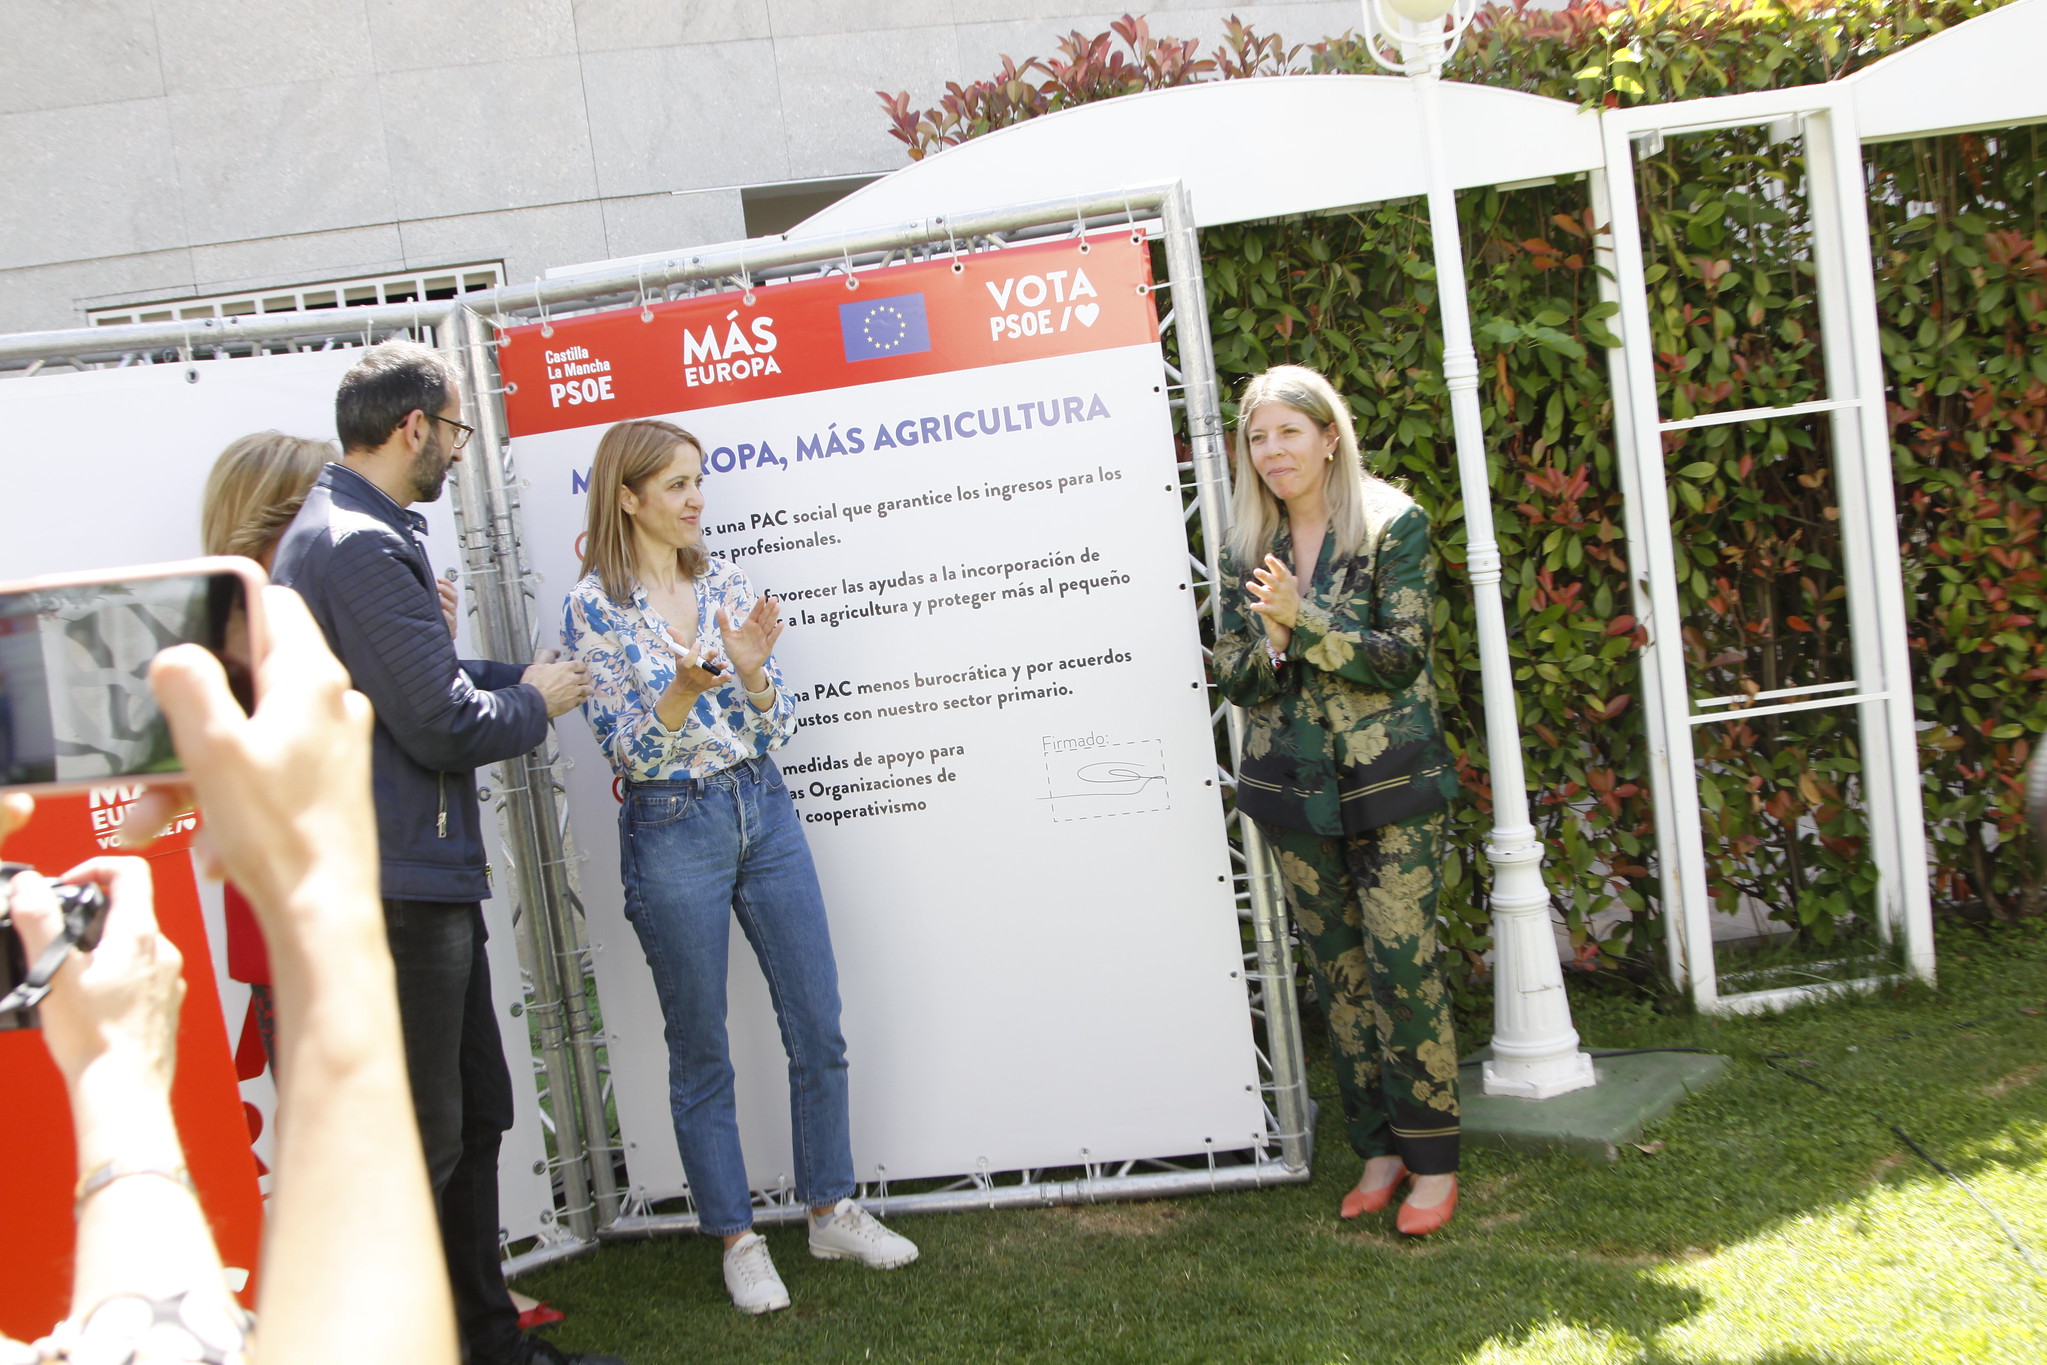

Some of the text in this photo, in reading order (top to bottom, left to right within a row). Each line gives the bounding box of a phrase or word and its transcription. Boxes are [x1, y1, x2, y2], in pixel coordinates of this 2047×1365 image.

[985, 267, 1098, 311] VOTA
[683, 309, 778, 365] MÁS
[990, 309, 1054, 342] PSOE
[545, 345, 589, 364] Castilla
[547, 358, 611, 380] La Mancha
[684, 355, 782, 387] EUROPA
[549, 375, 615, 408] PSOE
[797, 422, 865, 461] MÁS
[873, 392, 1112, 451] AGRICULTURA
[716, 521, 746, 535] una
[750, 510, 789, 530] PAC
[792, 502, 838, 524] social
[842, 503, 872, 523] que
[877, 490, 953, 518] garantice
[956, 485, 980, 501] los
[984, 482, 1053, 501] ingresos
[1057, 472, 1094, 493] para
[1098, 466, 1122, 482] los
[731, 531, 842, 564] profesionales.
[841, 579, 864, 594] las
[868, 570, 925, 596] ayudas
[929, 573, 938, 583] a
[941, 565, 957, 581] la
[961, 551, 1075, 579] incorporación
[1080, 547, 1100, 562] de
[789, 569, 1131, 628] a la agricultura y proteger más al pequeño
[814, 681, 852, 700] PAC
[857, 679, 910, 695] menos
[914, 664, 1007, 688] burocrática
[1012, 665, 1021, 682] y
[1026, 661, 1054, 680] por
[1059, 648, 1132, 670] acuerdos
[843, 709, 873, 722] con
[877, 700, 939, 718] nuestro
[943, 694, 992, 710] sector
[997, 682, 1073, 709] primario.
[1042, 731, 1110, 751] Firmado:
[782, 745, 965, 776] medidas de apoyo para
[809, 774, 933, 801] Organizaciones
[937, 767, 957, 783] de
[805, 799, 927, 826] cooperativismo
